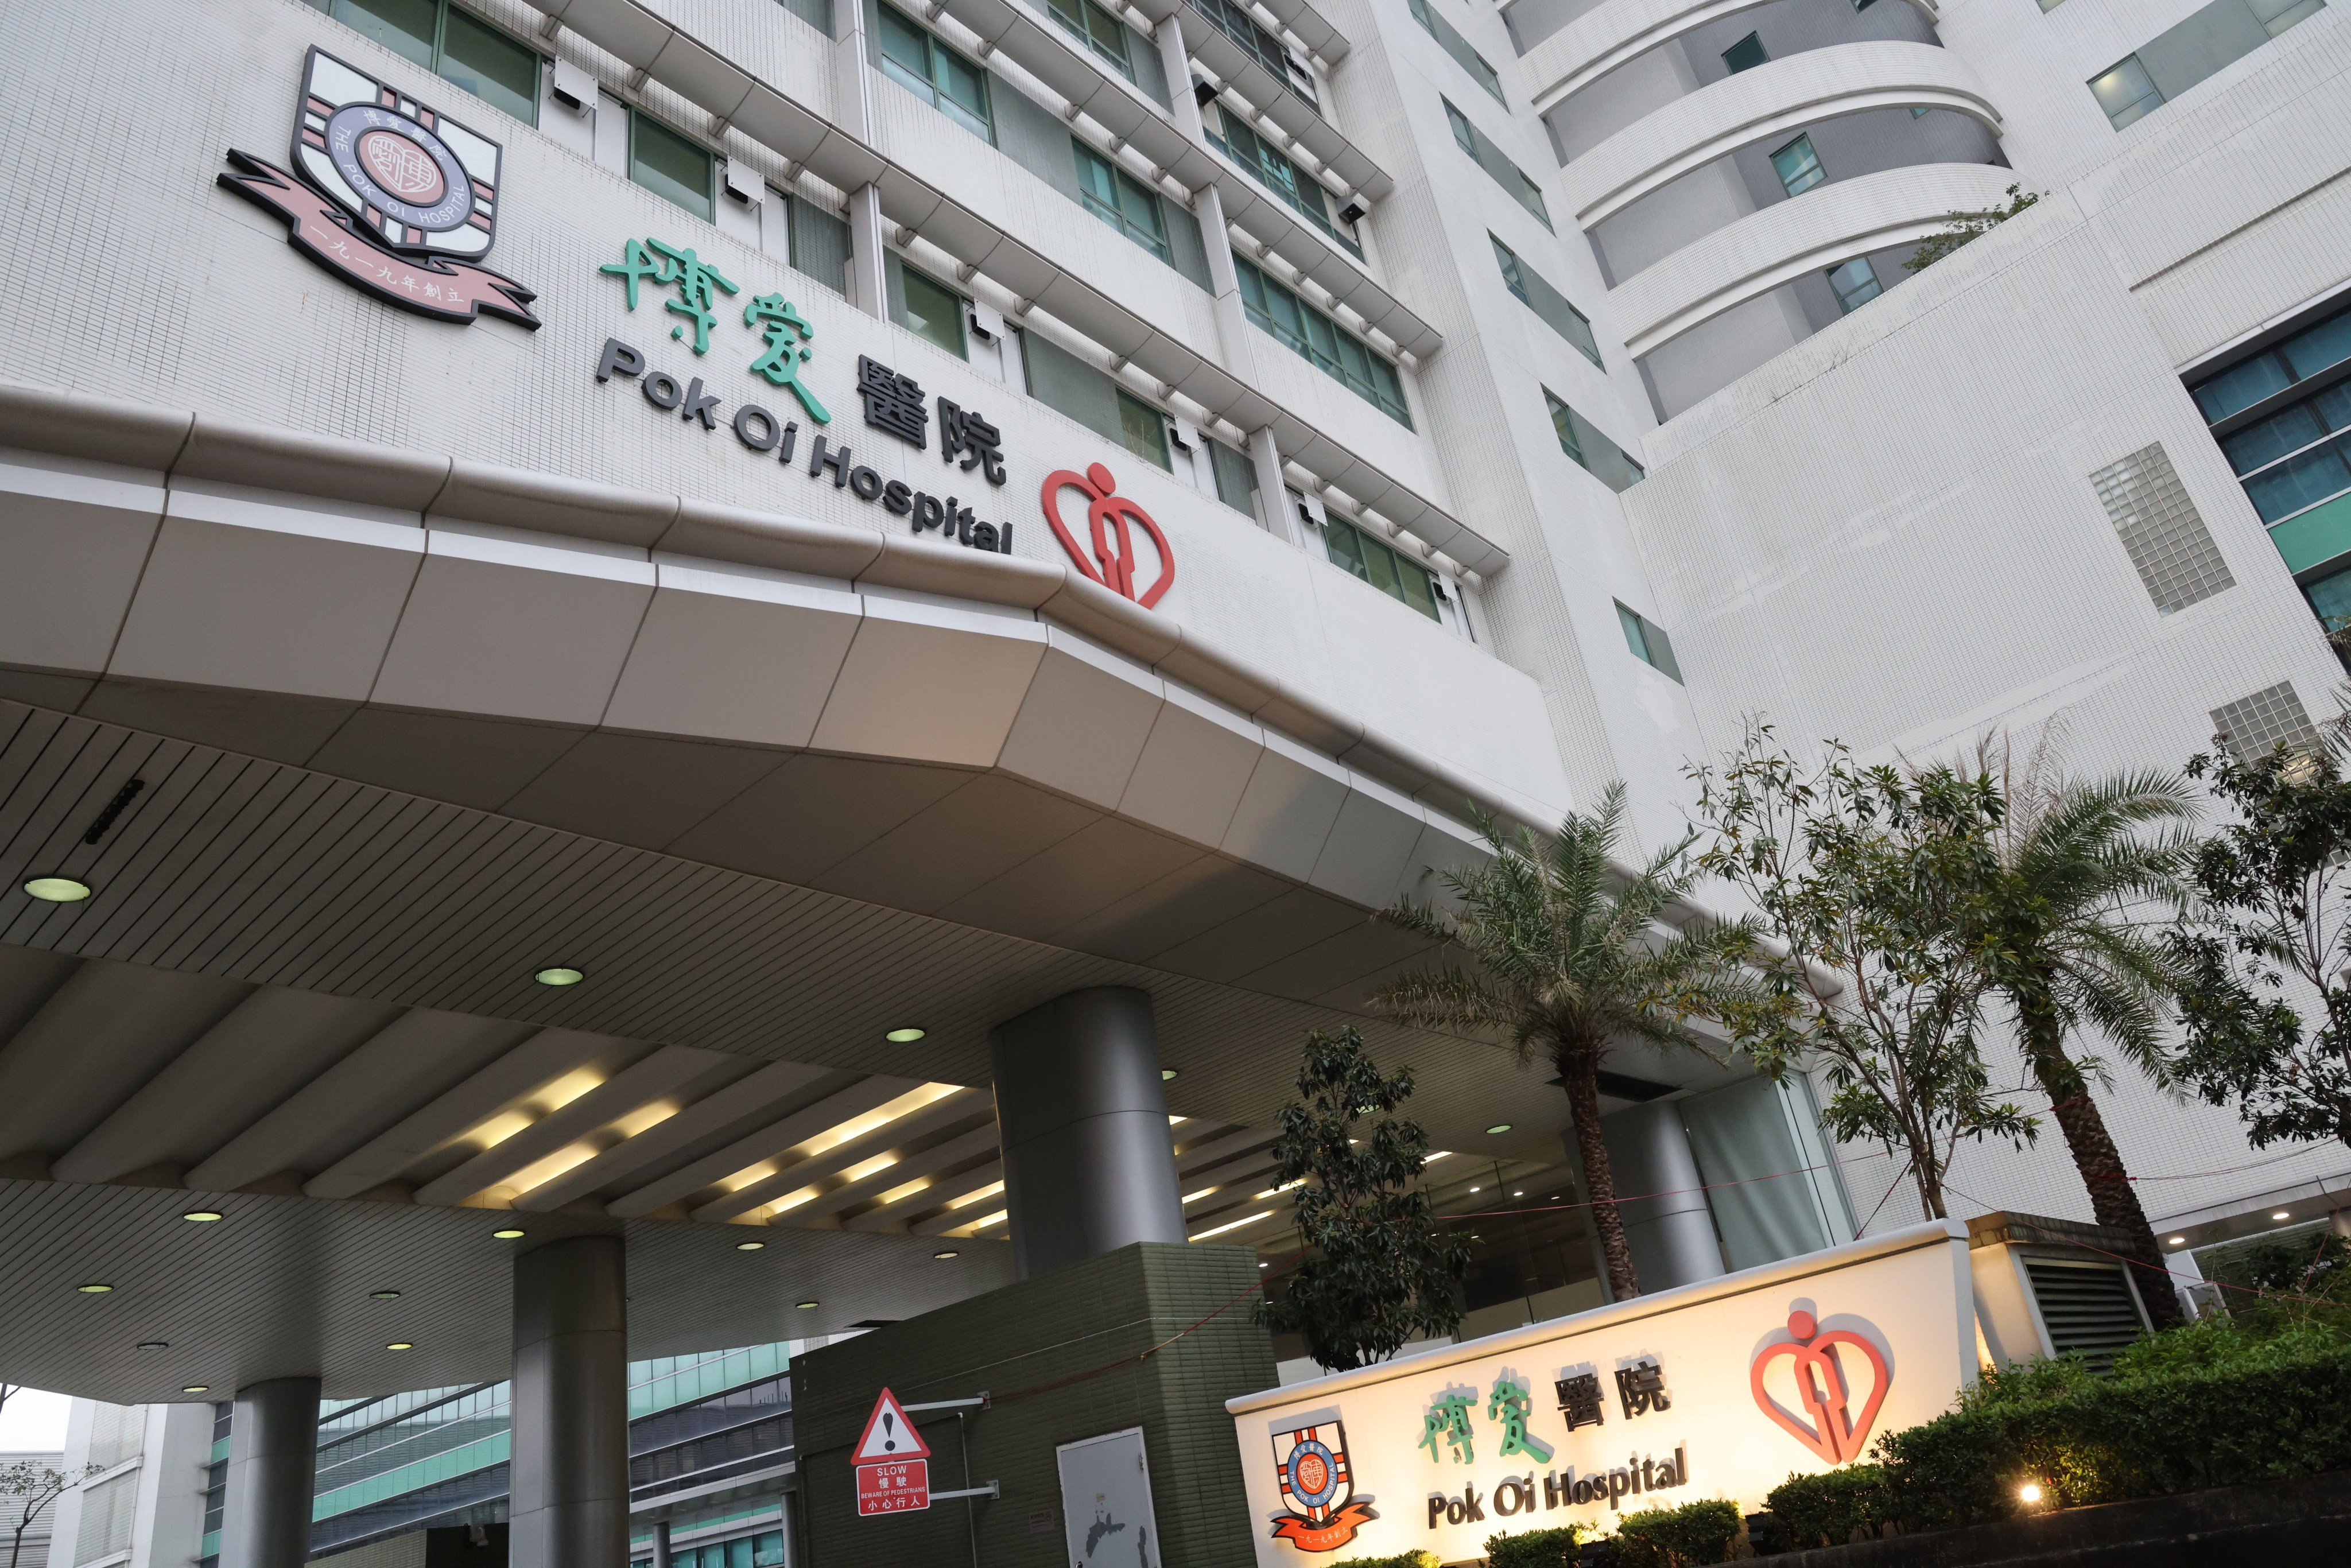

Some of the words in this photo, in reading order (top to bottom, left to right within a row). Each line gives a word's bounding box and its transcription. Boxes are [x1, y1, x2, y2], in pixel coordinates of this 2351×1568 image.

[363, 110, 447, 161] 博愛醫院
[335, 126, 351, 153] THE
[343, 164, 378, 197] POK
[387, 201, 405, 217] OI
[418, 185, 465, 224] HOSPITAL
[310, 226, 464, 304] 一九一九年創立
[595, 337, 721, 430] Pok
[733, 404, 798, 464] Oi
[810, 434, 1012, 555] Hospital
[1294, 1443, 1323, 1460] 博愛醫院
[877, 1465, 906, 1476] SLOW
[879, 1476, 906, 1489] 慢駛
[1297, 1490, 1309, 1503] POK
[1323, 1462, 1336, 1499] HOSPITAL
[891, 1487, 925, 1496] PEDESTRIANS
[1428, 1487, 1485, 1529] Pok
[1493, 1478, 1537, 1517] Oi
[1543, 1447, 1688, 1510] Hospital
[868, 1496, 920, 1511] 小心行人
[1298, 1526, 1348, 1544] 一九一九年創立
